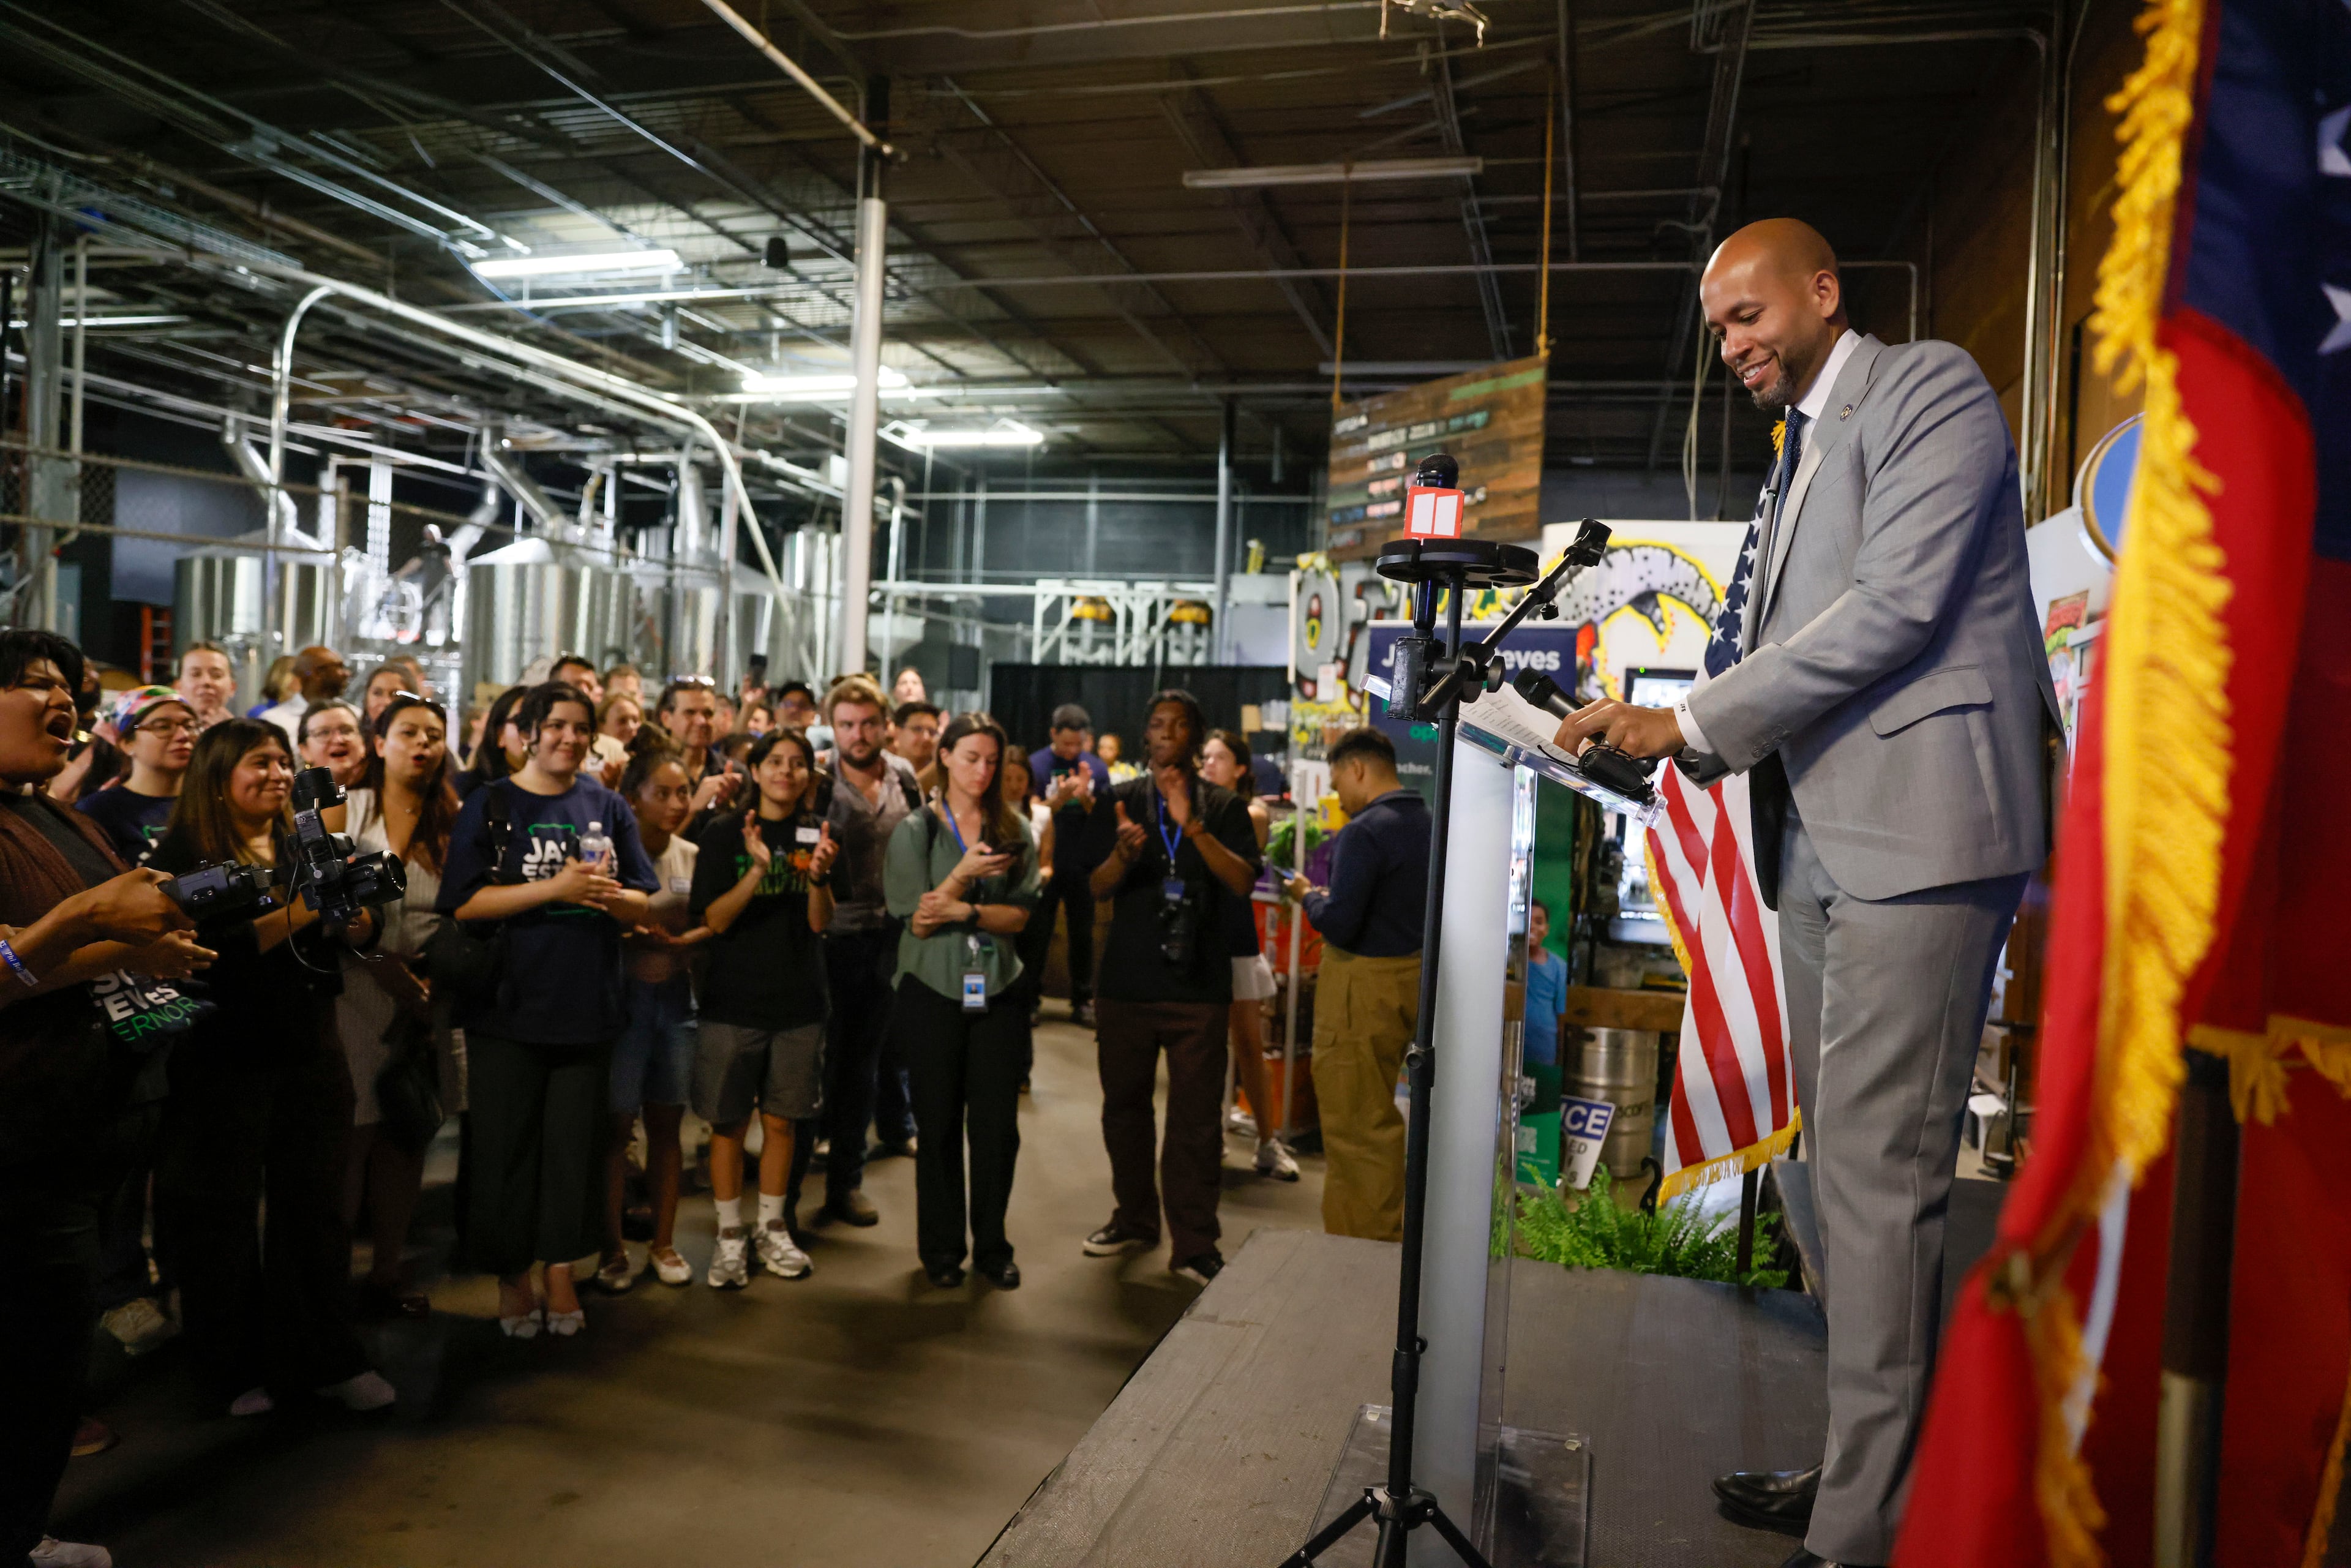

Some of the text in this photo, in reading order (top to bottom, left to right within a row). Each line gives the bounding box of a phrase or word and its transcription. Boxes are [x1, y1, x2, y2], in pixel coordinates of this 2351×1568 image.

[1397, 763, 1432, 775] acher.
[93, 986, 179, 1021] EVES
[112, 997, 201, 1041] ERNOR
[1561, 1103, 1610, 1135] ICE
